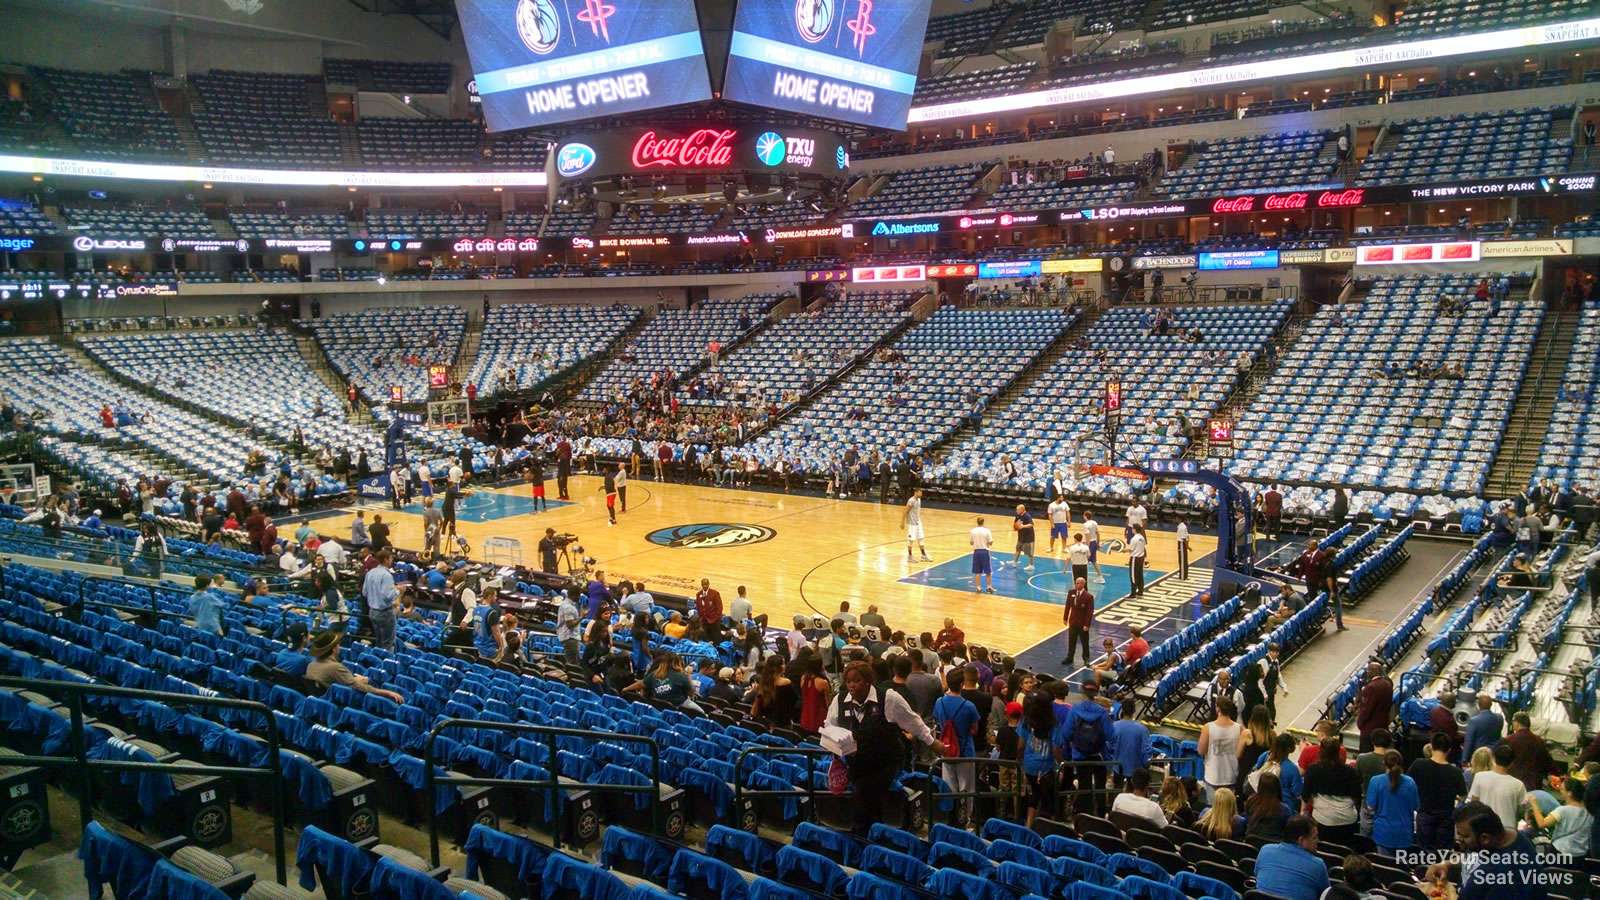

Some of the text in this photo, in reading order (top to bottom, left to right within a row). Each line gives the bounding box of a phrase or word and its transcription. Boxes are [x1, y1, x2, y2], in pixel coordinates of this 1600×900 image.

[1545, 28, 1590, 41] SNAPCHAT
[1355, 48, 1432, 64] SNAPCHAT AACDallas
[526, 72, 650, 114] HOME OPENER
[774, 71, 875, 114] HOME OPENER
[632, 129, 738, 168] Coca-Cola
[786, 136, 816, 156] TXU
[560, 150, 585, 172] Ford
[786, 154, 814, 168] energy
[1559, 176, 1595, 186] COMING
[1567, 182, 1594, 190] SOON
[1412, 182, 1535, 197] THE NEW VICTORY PARK
[1264, 193, 1308, 210] Coca-Cola
[1318, 190, 1364, 206] Coca-Cola
[1213, 196, 1256, 213] Coca-Cola
[1092, 208, 1119, 219] LSO
[890, 222, 940, 234] Albertsons
[776, 230, 806, 239] DOWNLOAD
[0, 238, 34, 253] nager
[94, 240, 145, 250] LEXUS
[454, 238, 473, 252] citi
[476, 238, 494, 252] citi
[497, 238, 516, 252] citi
[518, 238, 537, 252] citi
[620, 238, 655, 246] BOWMAN,
[656, 237, 670, 245] INC.
[117, 286, 156, 295] CyrusOne
[432, 374, 444, 384] 24
[1214, 428, 1227, 438] 24
[1129, 471, 1142, 479] Farm
[362, 484, 386, 496] SPALDING
[814, 618, 822, 628] G
[867, 629, 877, 641] G
[907, 637, 916, 648] G
[991, 651, 1000, 663] G
[16, 785, 23, 796] S
